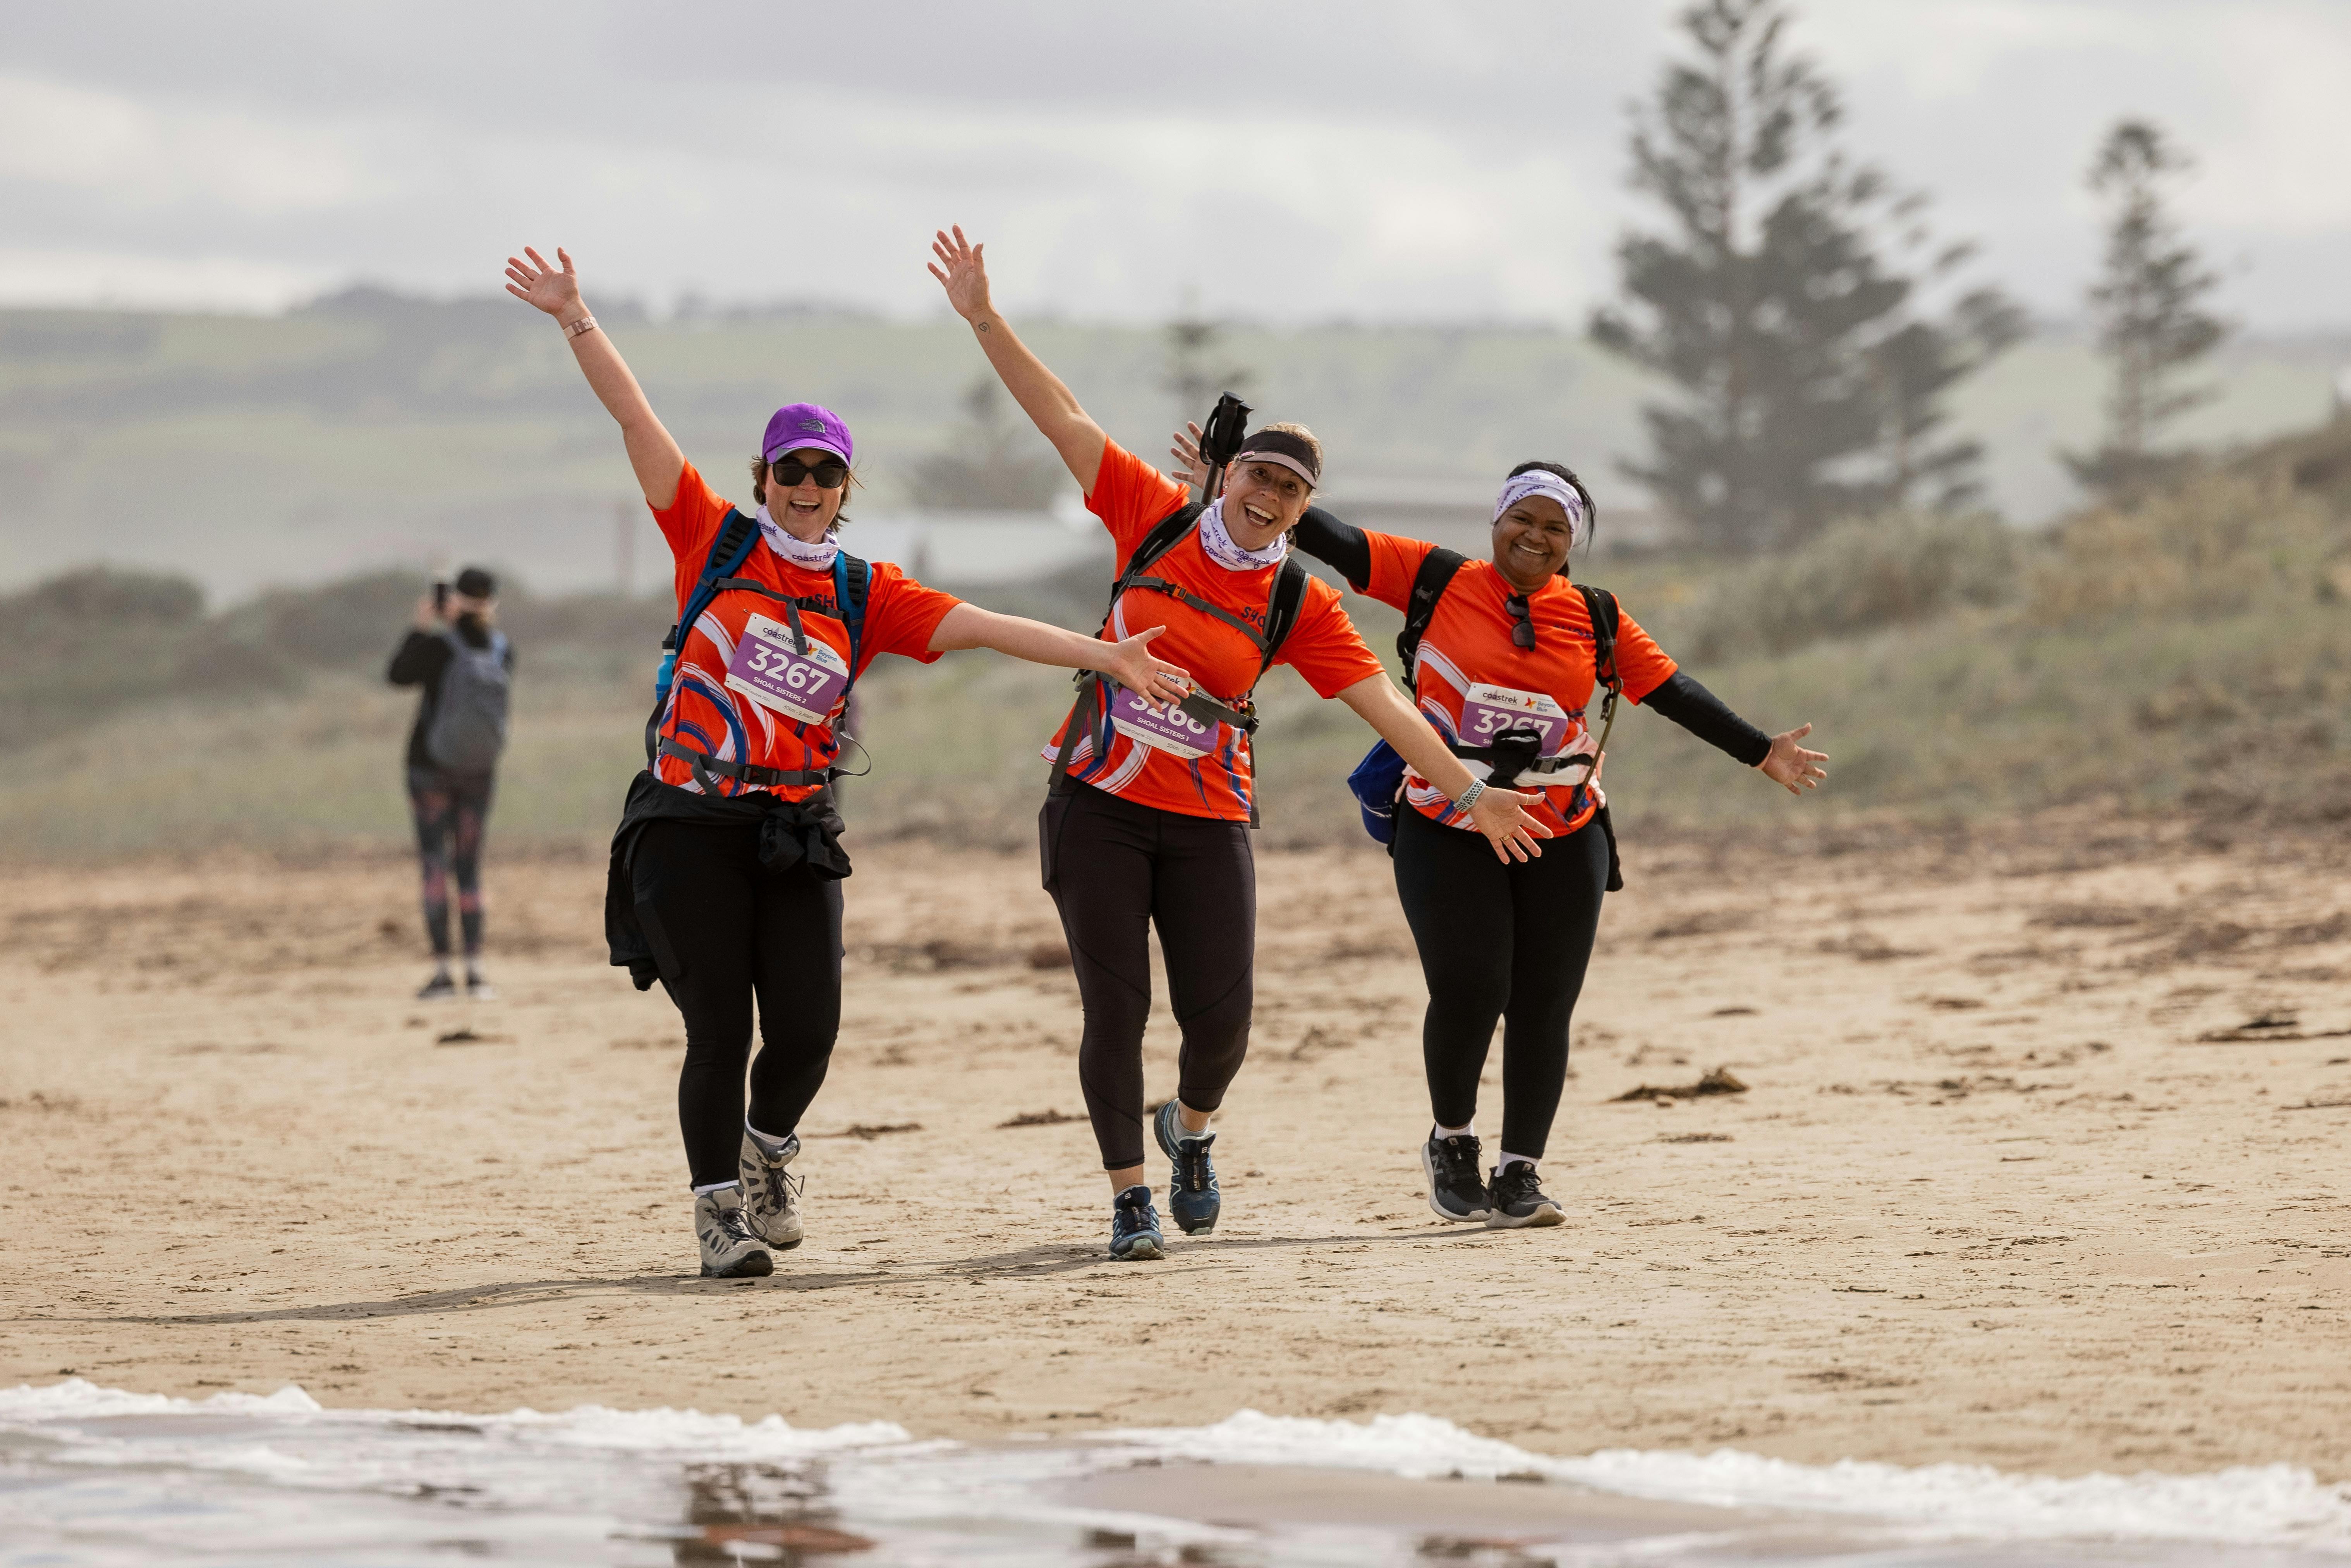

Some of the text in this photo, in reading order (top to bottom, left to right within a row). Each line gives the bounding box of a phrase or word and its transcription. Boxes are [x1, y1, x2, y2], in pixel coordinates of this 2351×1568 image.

[816, 655, 828, 664] Blue
[818, 649, 838, 662] Beyond
[747, 643, 831, 695] 3267
[753, 677, 775, 690] SHOAL
[775, 687, 802, 703] SISTERS
[1483, 692, 1518, 704] coastrek
[783, 704, 796, 713] 30km
[799, 711, 814, 720] 9.30am
[1136, 717, 1159, 730] SHOAL
[1159, 726, 1185, 740] SISTERS
[1166, 742, 1180, 751] 30km
[1183, 748, 1200, 757] 9.30am
